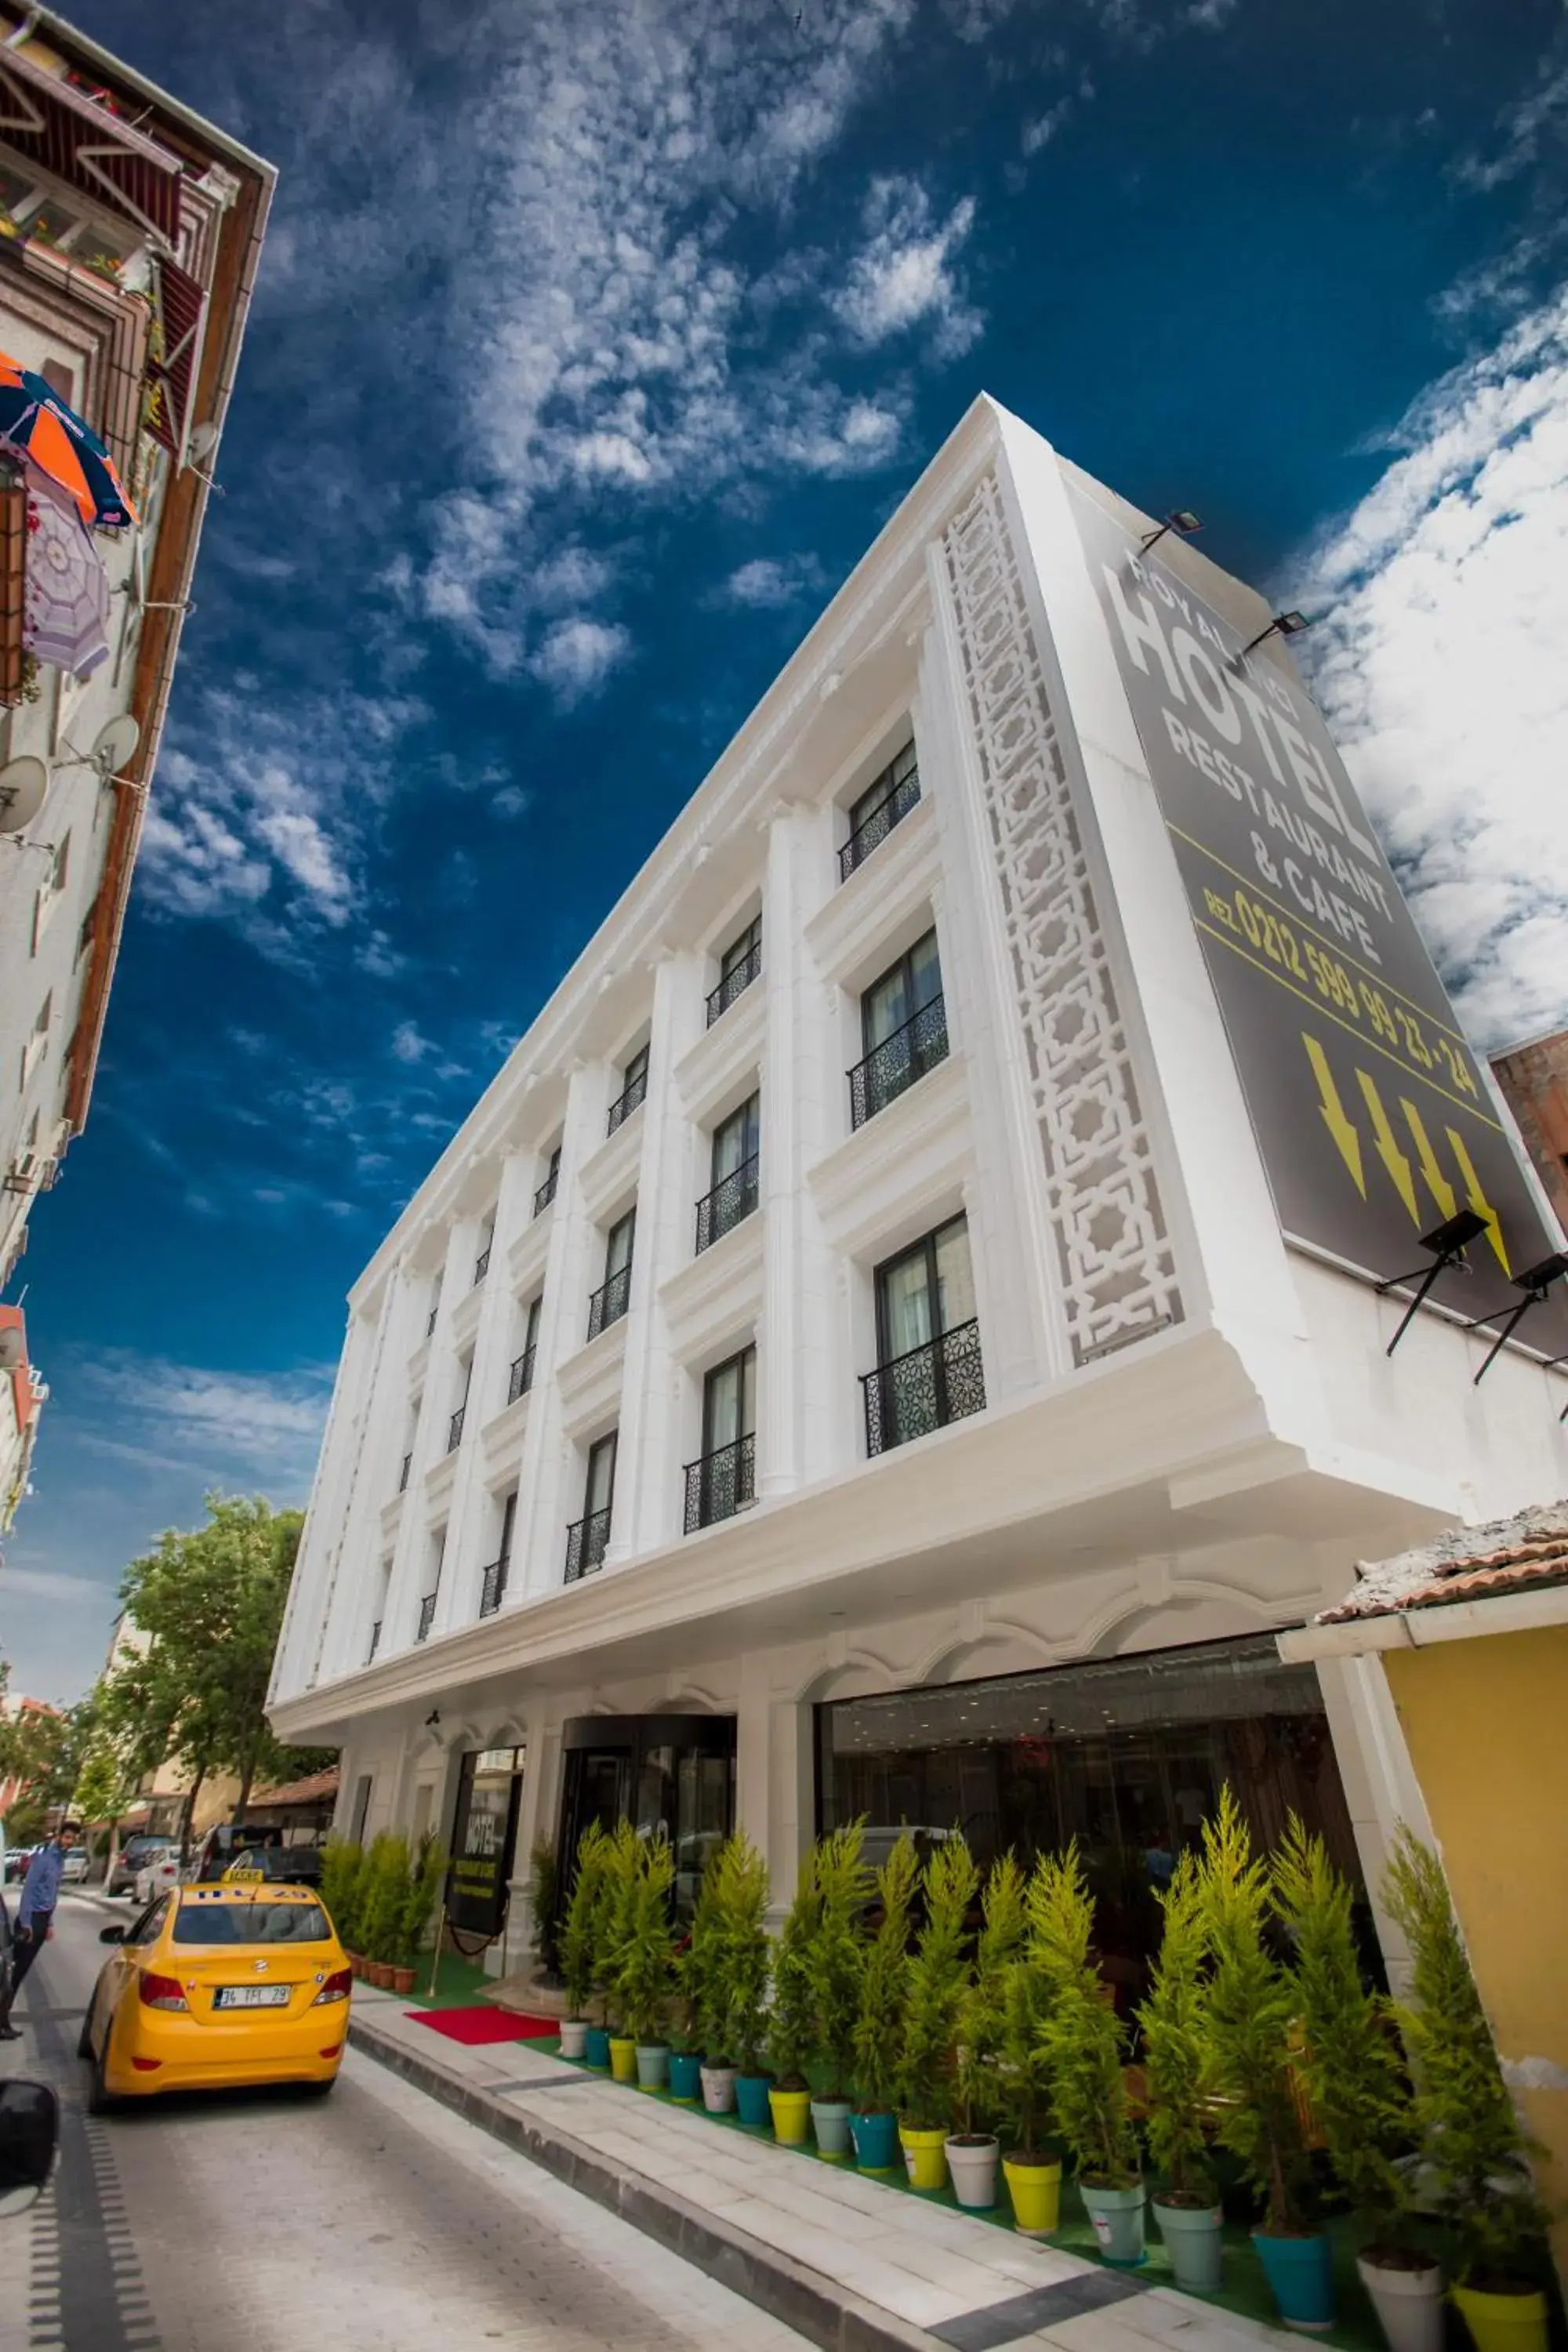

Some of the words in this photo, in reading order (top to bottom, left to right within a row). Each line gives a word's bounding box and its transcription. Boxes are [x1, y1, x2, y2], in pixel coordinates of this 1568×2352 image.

[1124, 547, 1238, 666] ROYAL
[1102, 563, 1381, 868] HOTEL
[1162, 707, 1393, 923] RESTAURANT
[1234, 890, 1309, 983] 0212
[1303, 940, 1360, 1018] 599
[1358, 980, 1399, 1046] 99
[1394, 1006, 1433, 1069] 23
[1438, 1037, 1479, 1102] 24
[1250, 830, 1282, 889] &
[1283, 857, 1382, 966] CAFE
